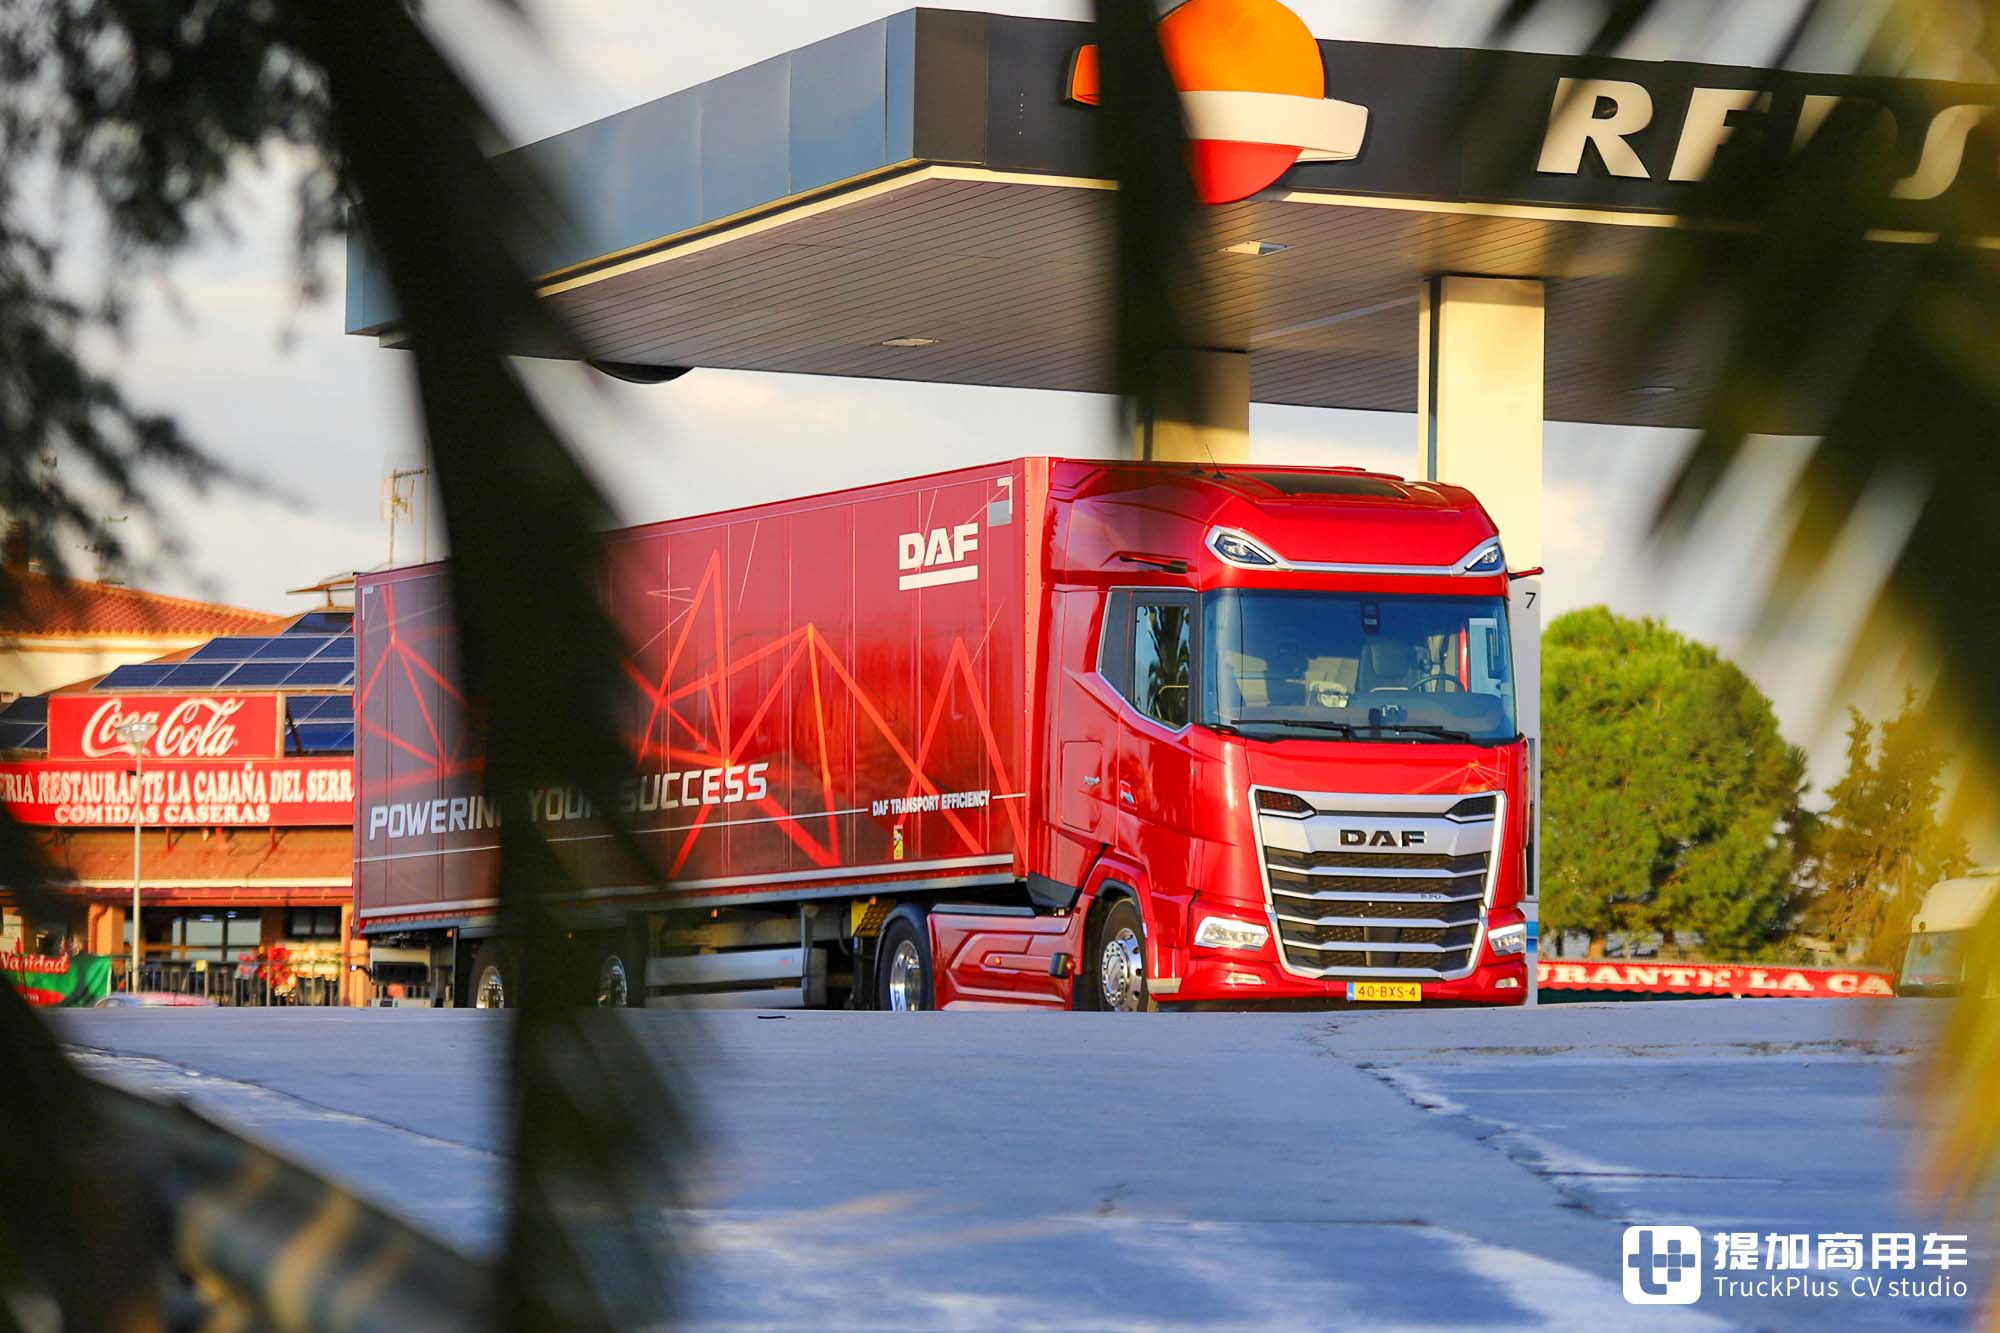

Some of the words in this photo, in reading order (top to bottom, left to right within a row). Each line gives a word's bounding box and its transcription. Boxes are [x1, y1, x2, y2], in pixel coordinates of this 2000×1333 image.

[899, 523, 978, 570] DAF
[1525, 592, 1536, 608] 7
[167, 770, 191, 804] LA
[193, 761, 267, 804] CABAÑA
[270, 769, 304, 803] DEL
[306, 769, 355, 802] SERR
[369, 795, 502, 840] POWERIN
[527, 786, 593, 822] YOU
[621, 763, 769, 813] SUCCESS
[872, 800, 889, 816] DAF
[891, 793, 940, 815] TRANSPORT
[941, 789, 991, 809] EFFICIENCY
[54, 804, 160, 823] COMIDAS
[164, 804, 270, 823] CASERAS
[1340, 829, 1425, 847] DAF
[1358, 985, 1416, 998] 40-BXS-4
[1748, 970, 1815, 992] LA
